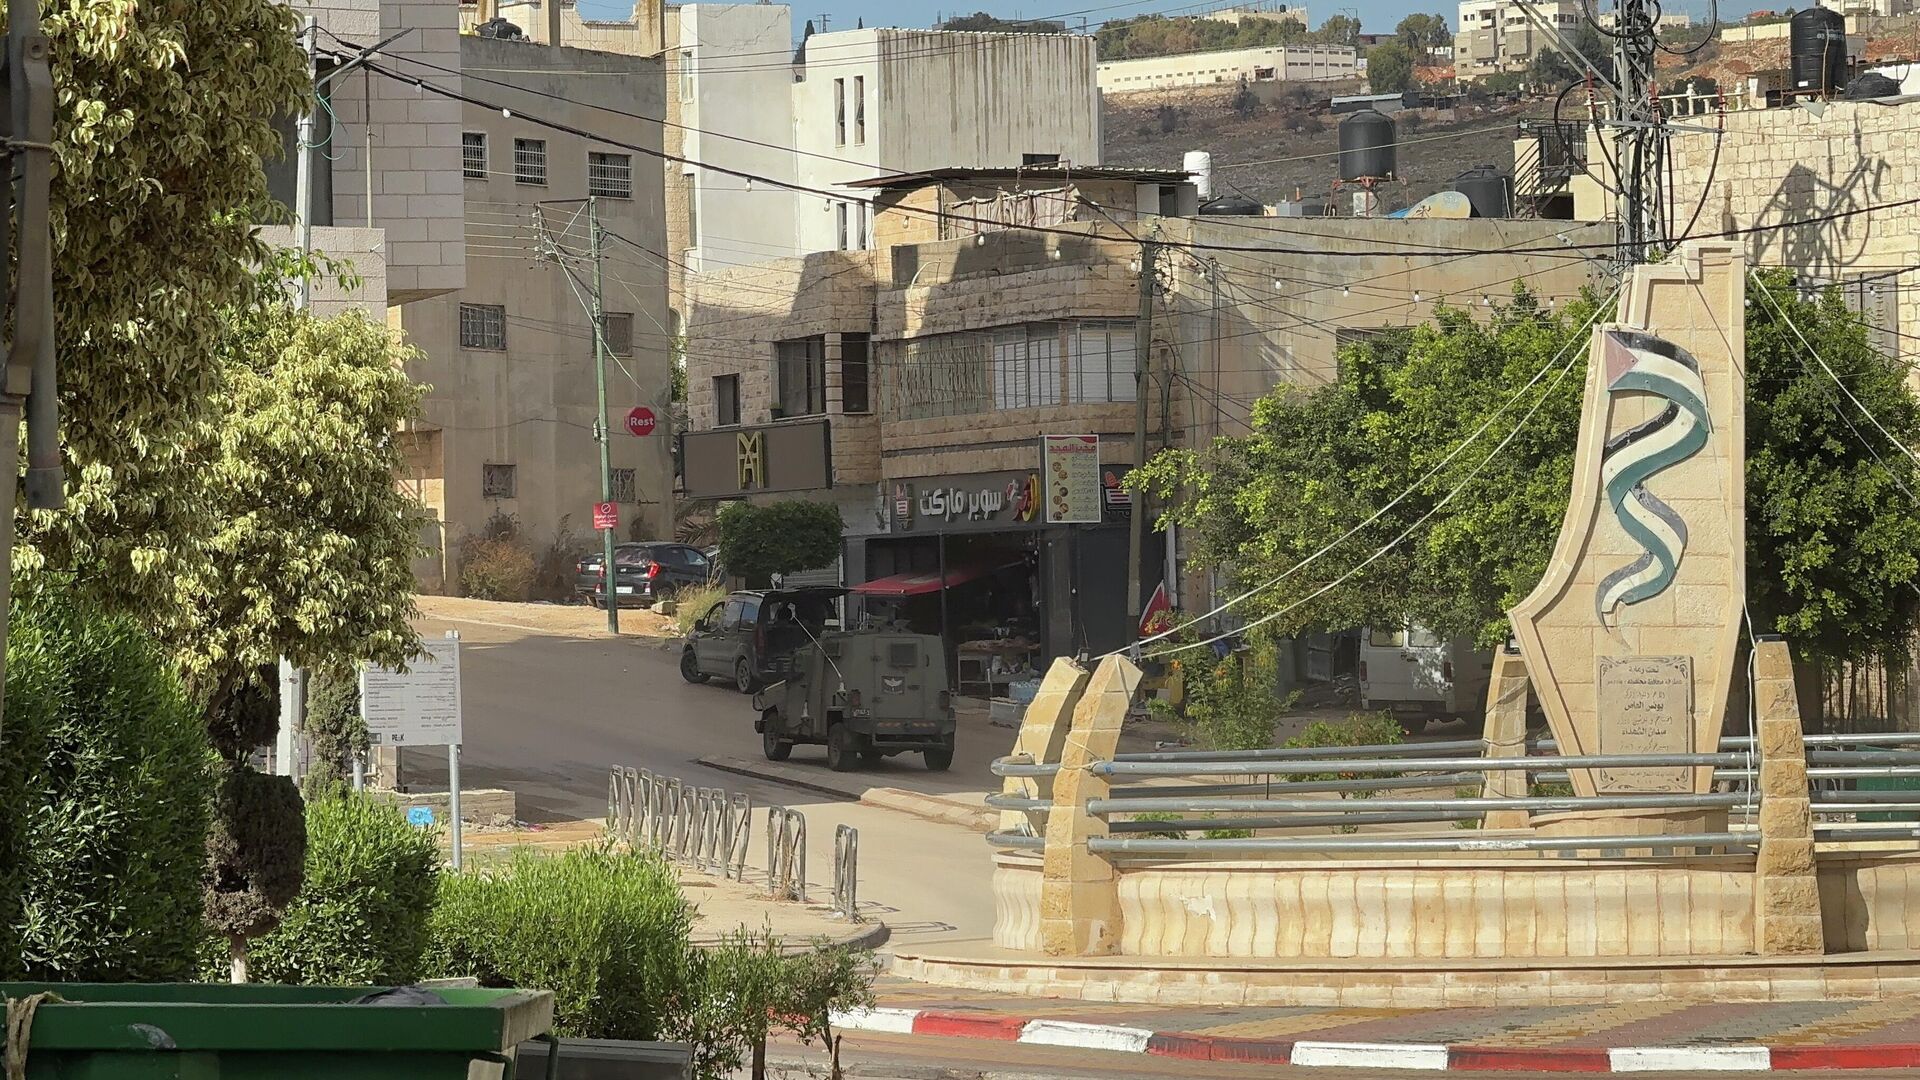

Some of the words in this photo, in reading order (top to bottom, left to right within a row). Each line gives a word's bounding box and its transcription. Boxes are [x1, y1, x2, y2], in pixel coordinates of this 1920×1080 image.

[630, 416, 654, 426] Rest
[919, 488, 965, 522] ماركت
[968, 489, 1002, 521] سوبر
